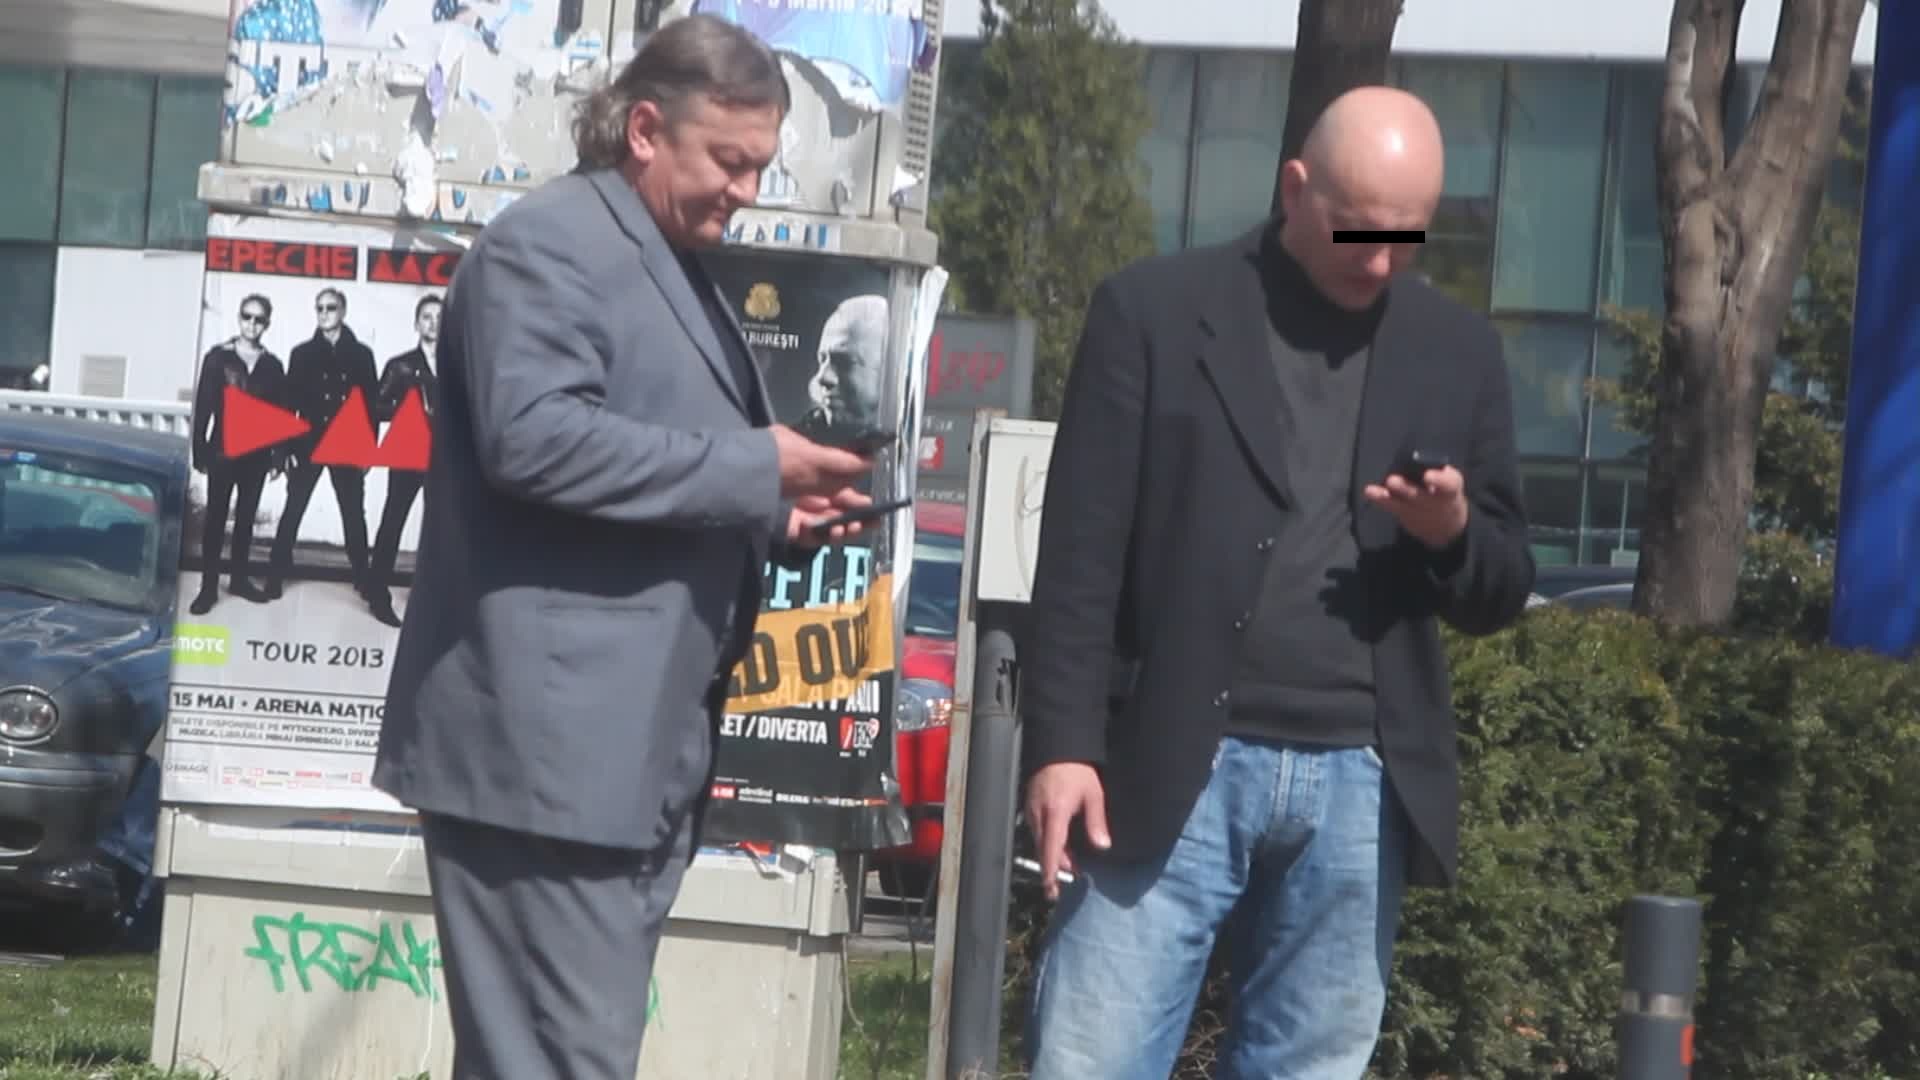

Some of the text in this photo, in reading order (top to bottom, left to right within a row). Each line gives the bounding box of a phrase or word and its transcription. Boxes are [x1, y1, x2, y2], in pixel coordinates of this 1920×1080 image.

[247, 640, 384, 668] TOUR 2013
[173, 692, 193, 707] 15
[197, 693, 234, 710] MAI
[254, 698, 324, 716] ARENA
